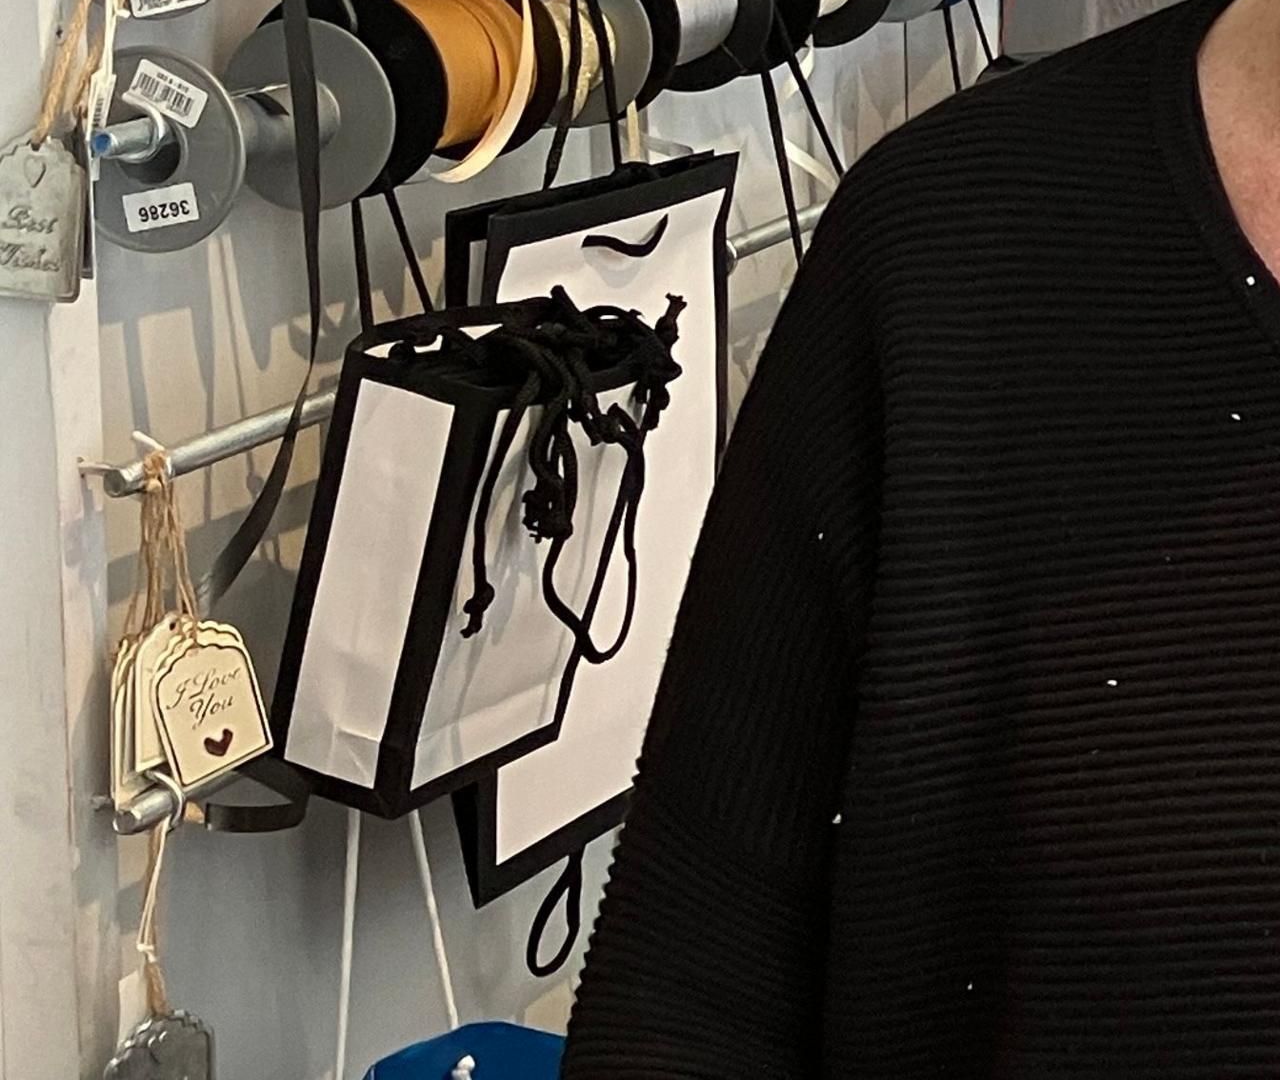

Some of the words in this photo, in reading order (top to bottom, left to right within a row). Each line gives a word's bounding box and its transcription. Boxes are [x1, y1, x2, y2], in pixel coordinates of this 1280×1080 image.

[138, 199, 190, 223] 36286
[189, 667, 241, 699] Love
[190, 692, 234, 730] You
